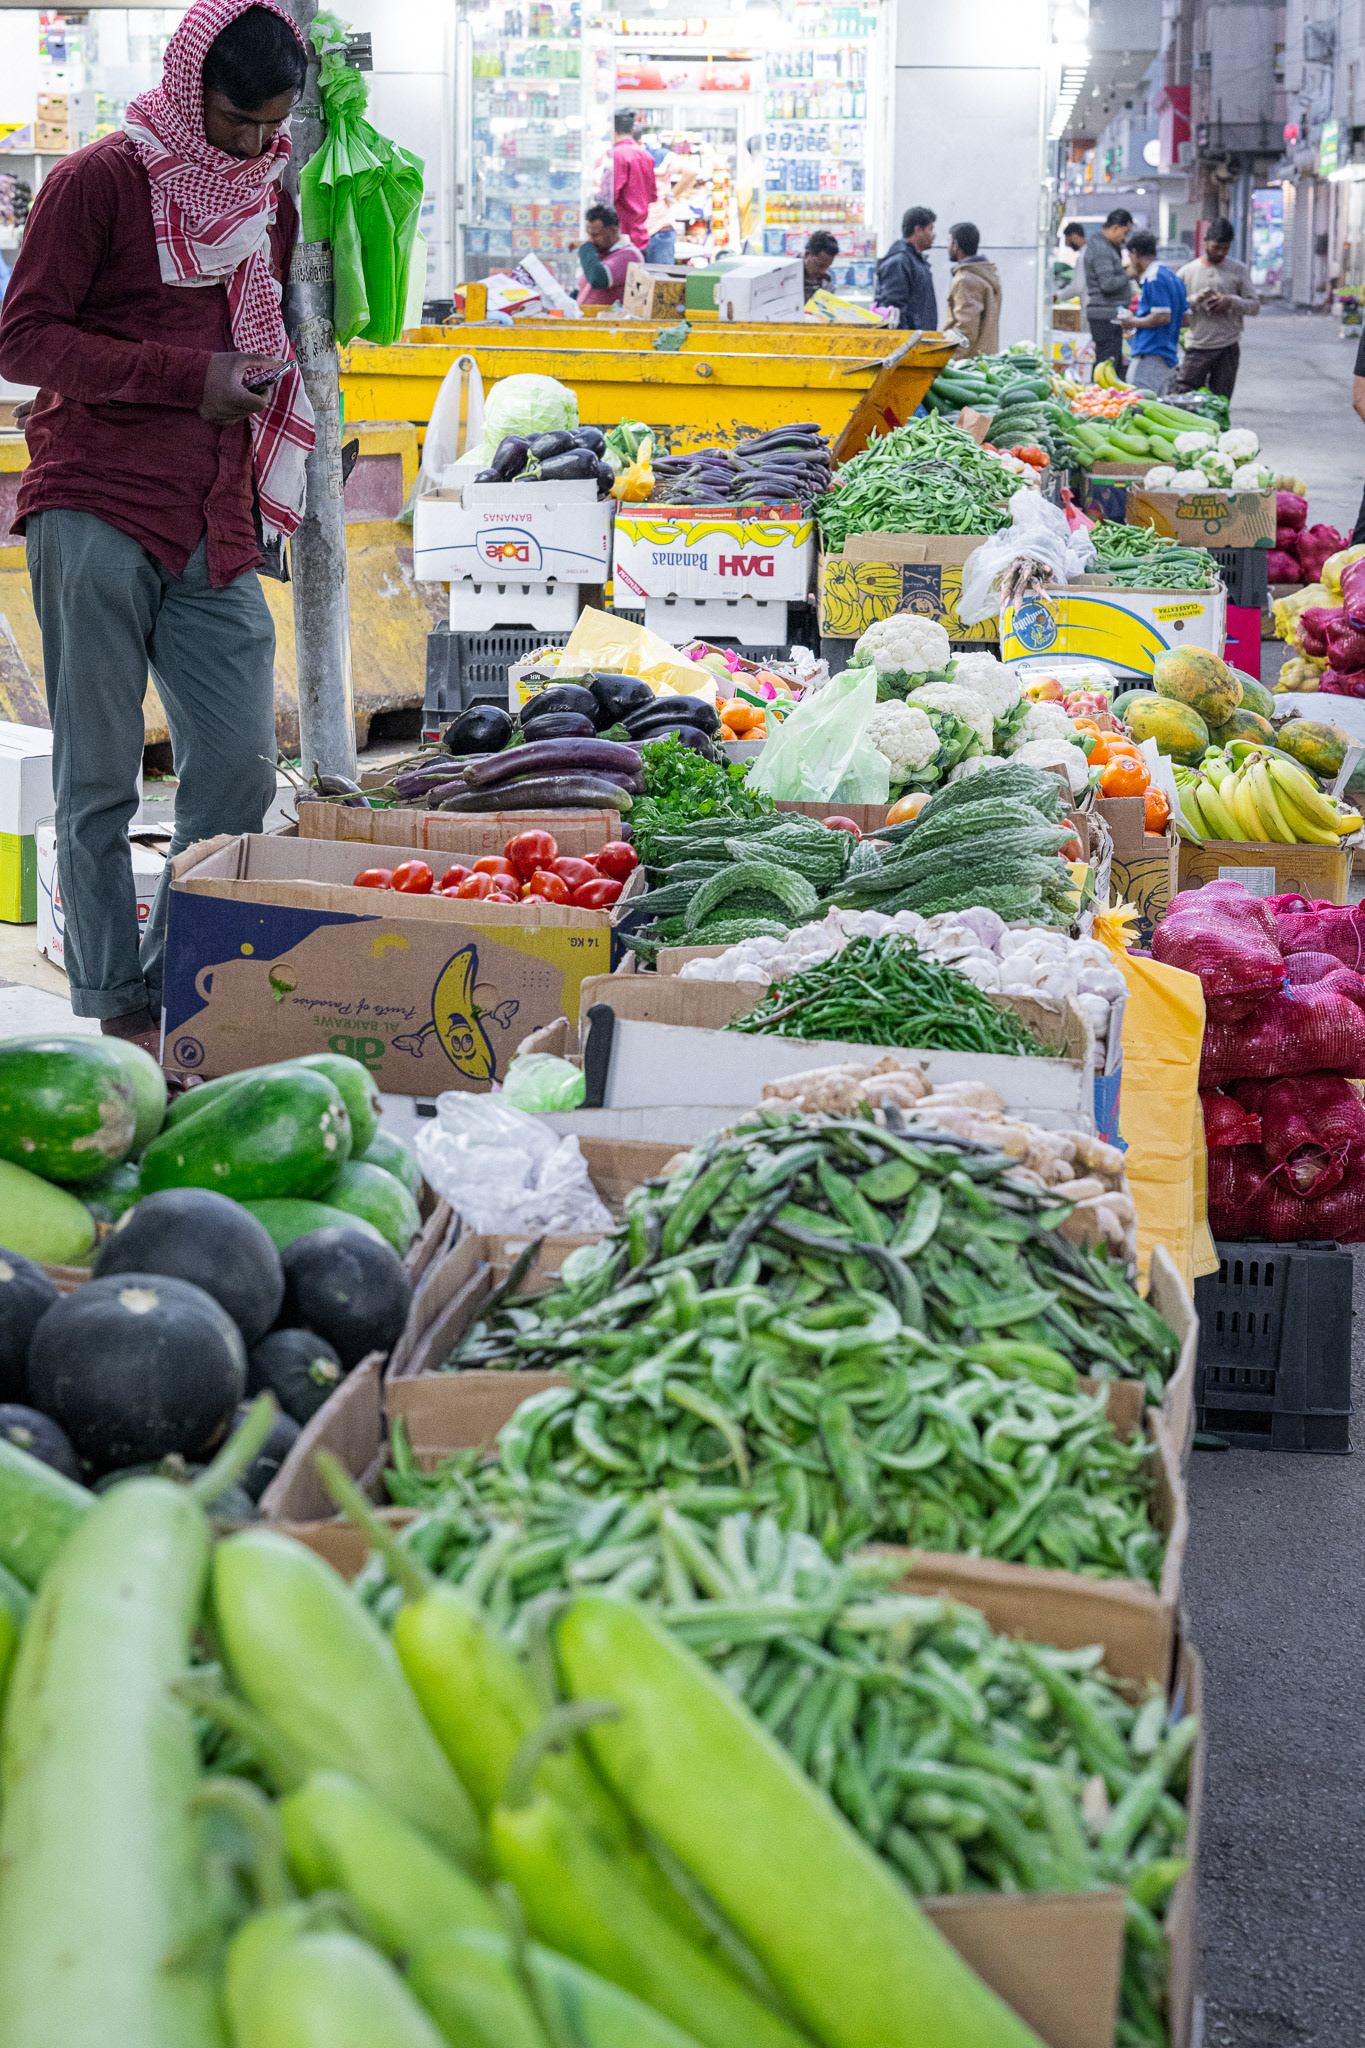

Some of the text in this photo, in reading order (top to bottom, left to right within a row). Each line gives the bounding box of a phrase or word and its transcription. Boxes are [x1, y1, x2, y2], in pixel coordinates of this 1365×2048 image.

[483, 513, 532, 522] BANANAS
[1177, 502, 1228, 519] VICTOR
[485, 544, 530, 562] Dole
[652, 552, 774, 577] DAH Bananas
[1158, 603, 1198, 614] CLASS EXTRA
[587, 937, 599, 947] 14
[292, 997, 417, 1020] Fruits of Paradise
[314, 1015, 400, 1032] AL BAKRAWE
